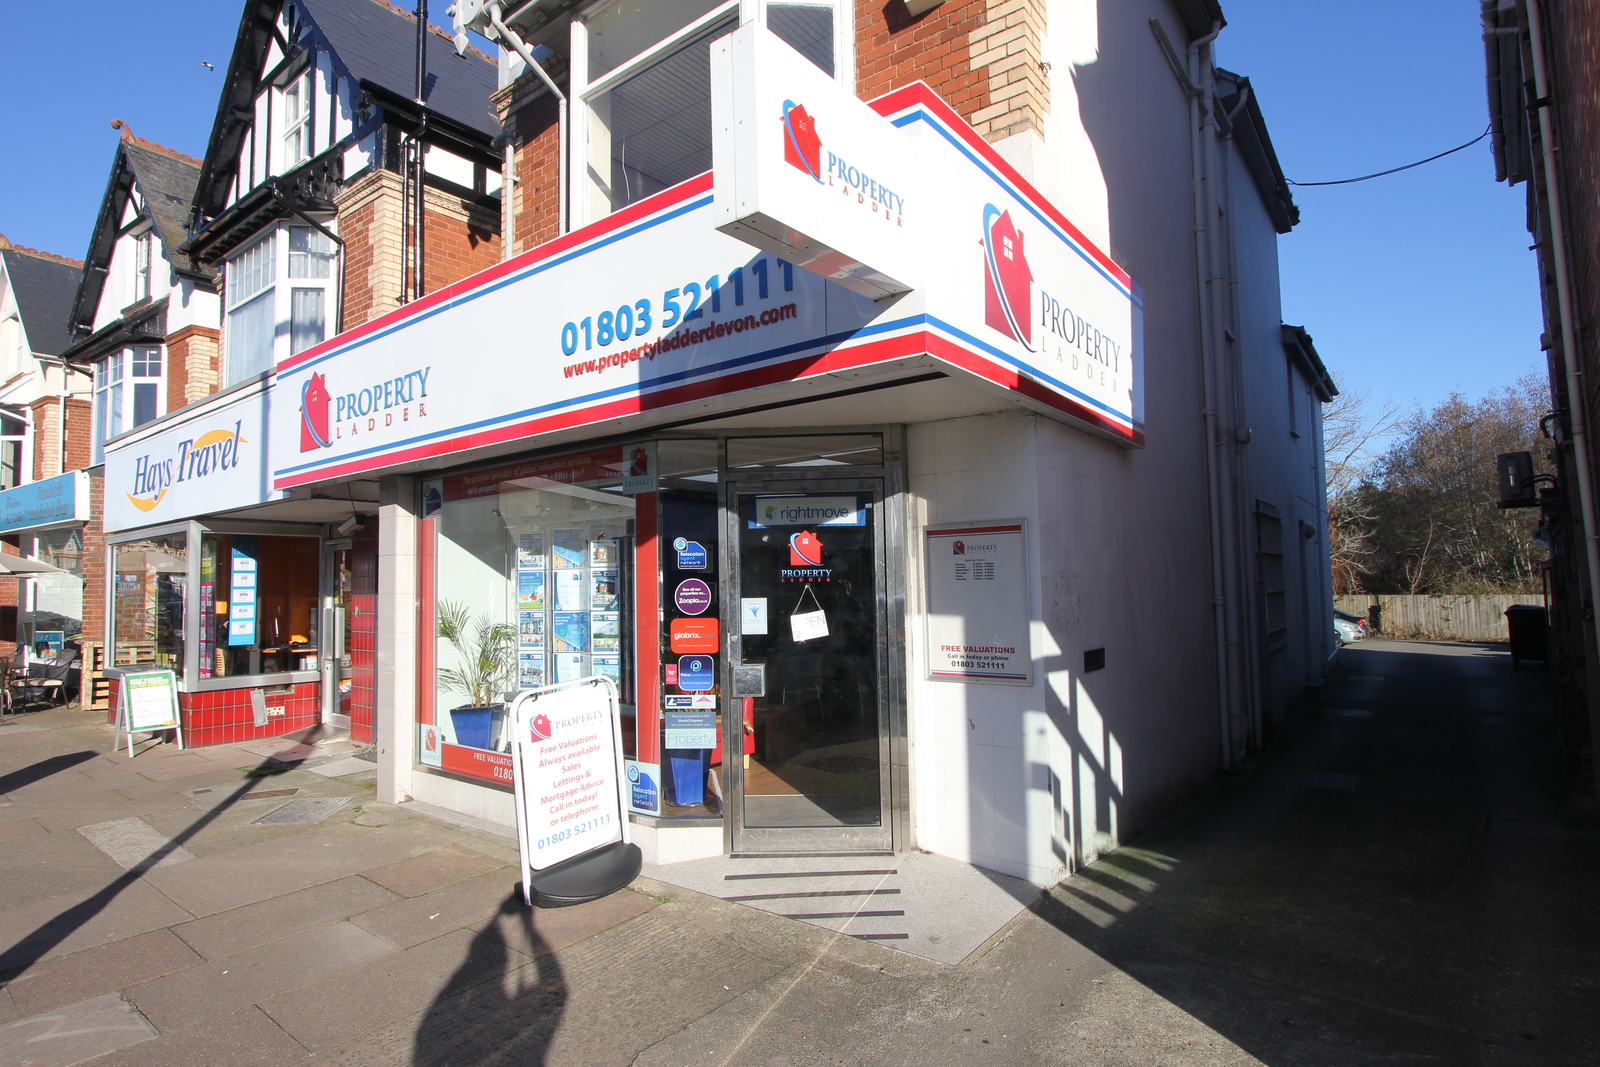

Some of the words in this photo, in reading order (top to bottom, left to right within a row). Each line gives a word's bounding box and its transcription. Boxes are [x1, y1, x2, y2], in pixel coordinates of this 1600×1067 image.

[827, 151, 904, 216] PROPERTY
[829, 175, 902, 227] LADDER
[561, 298, 653, 356] 01803
[662, 257, 794, 328] 521111
[563, 302, 797, 378] www.propertyladderdevon.com
[1041, 289, 1121, 373] PROPERTY
[1042, 335, 1118, 393] LADDER
[336, 366, 431, 422] PROPERTY
[336, 403, 427, 439] LADDER
[132, 454, 173, 501] Hays
[176, 419, 242, 483] Travel
[472, 474, 490, 485] premier
[491, 470, 512, 481] provider
[513, 467, 520, 477] of
[520, 465, 537, 476] global
[538, 460, 566, 472] relocation
[567, 456, 591, 466] services
[37, 481, 63, 500] Sandwich
[467, 486, 478, 495] sells
[478, 483, 499, 495] property
[625, 478, 654, 488] PROPERTY
[780, 506, 849, 522] rightmove
[780, 569, 832, 578] PROPERTY
[674, 631, 717, 640] globrix.com
[963, 646, 1015, 654] VALUATIONS
[555, 710, 603, 730] PROPERTY
[540, 746, 557, 755] Free
[558, 733, 598, 750] Valuations
[668, 733, 713, 746] Property
[473, 752, 486, 762] FREE
[487, 755, 512, 767] VALUATIO
[539, 755, 566, 768] Always
[568, 744, 600, 760] available
[493, 766, 513, 780] 0180
[561, 762, 581, 774] Sales
[541, 787, 578, 805] Mortgage
[580, 778, 604, 791] Advice
[553, 774, 584, 789] Lettings
[633, 785, 656, 796] Relocation
[549, 803, 564, 814] Call
[566, 801, 573, 809] in
[574, 792, 598, 807] today!
[633, 799, 653, 807] network
[550, 818, 559, 827] or
[561, 804, 599, 822] telephone
[538, 829, 571, 850] 01803
[575, 814, 611, 836] 521111
